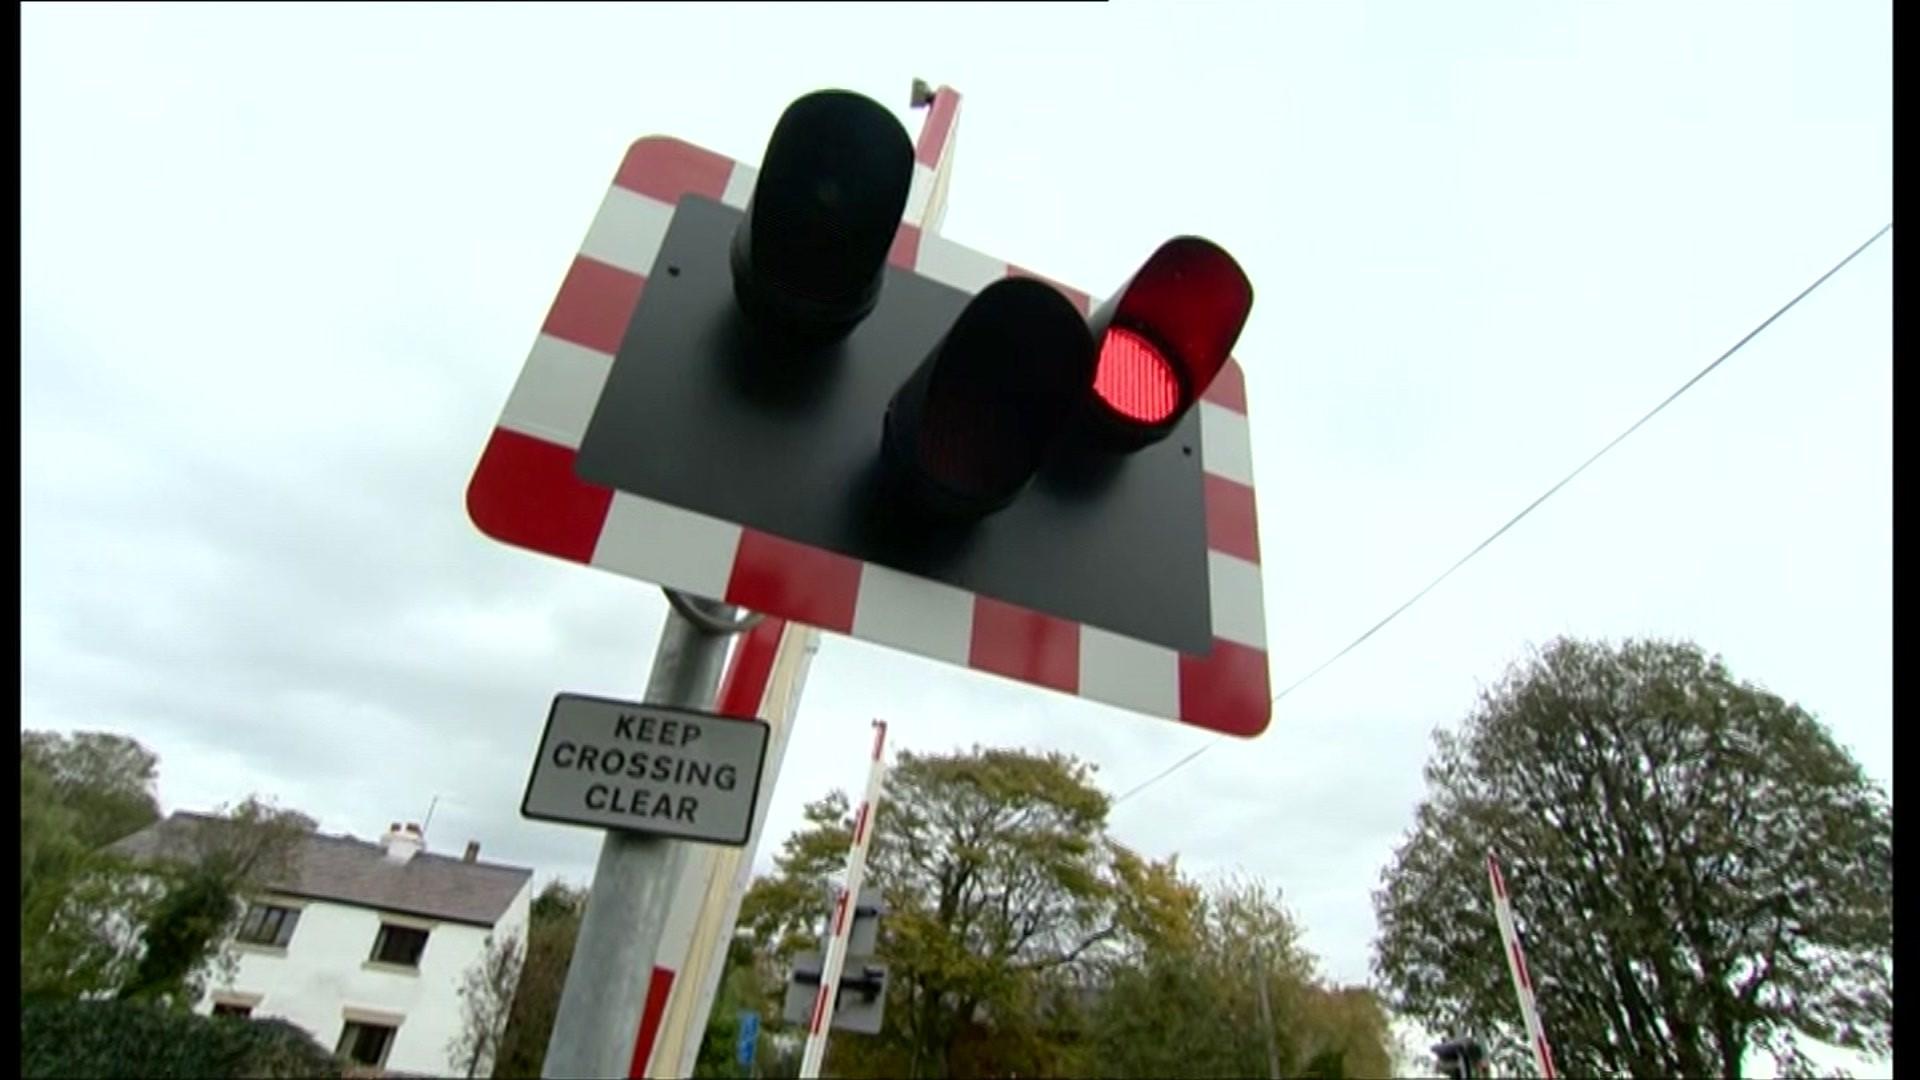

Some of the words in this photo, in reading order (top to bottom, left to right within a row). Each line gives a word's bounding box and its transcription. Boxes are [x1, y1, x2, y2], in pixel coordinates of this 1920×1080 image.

[614, 714, 701, 747] KEEP
[553, 742, 737, 791] CROSSING
[585, 785, 698, 823] CLEAR
